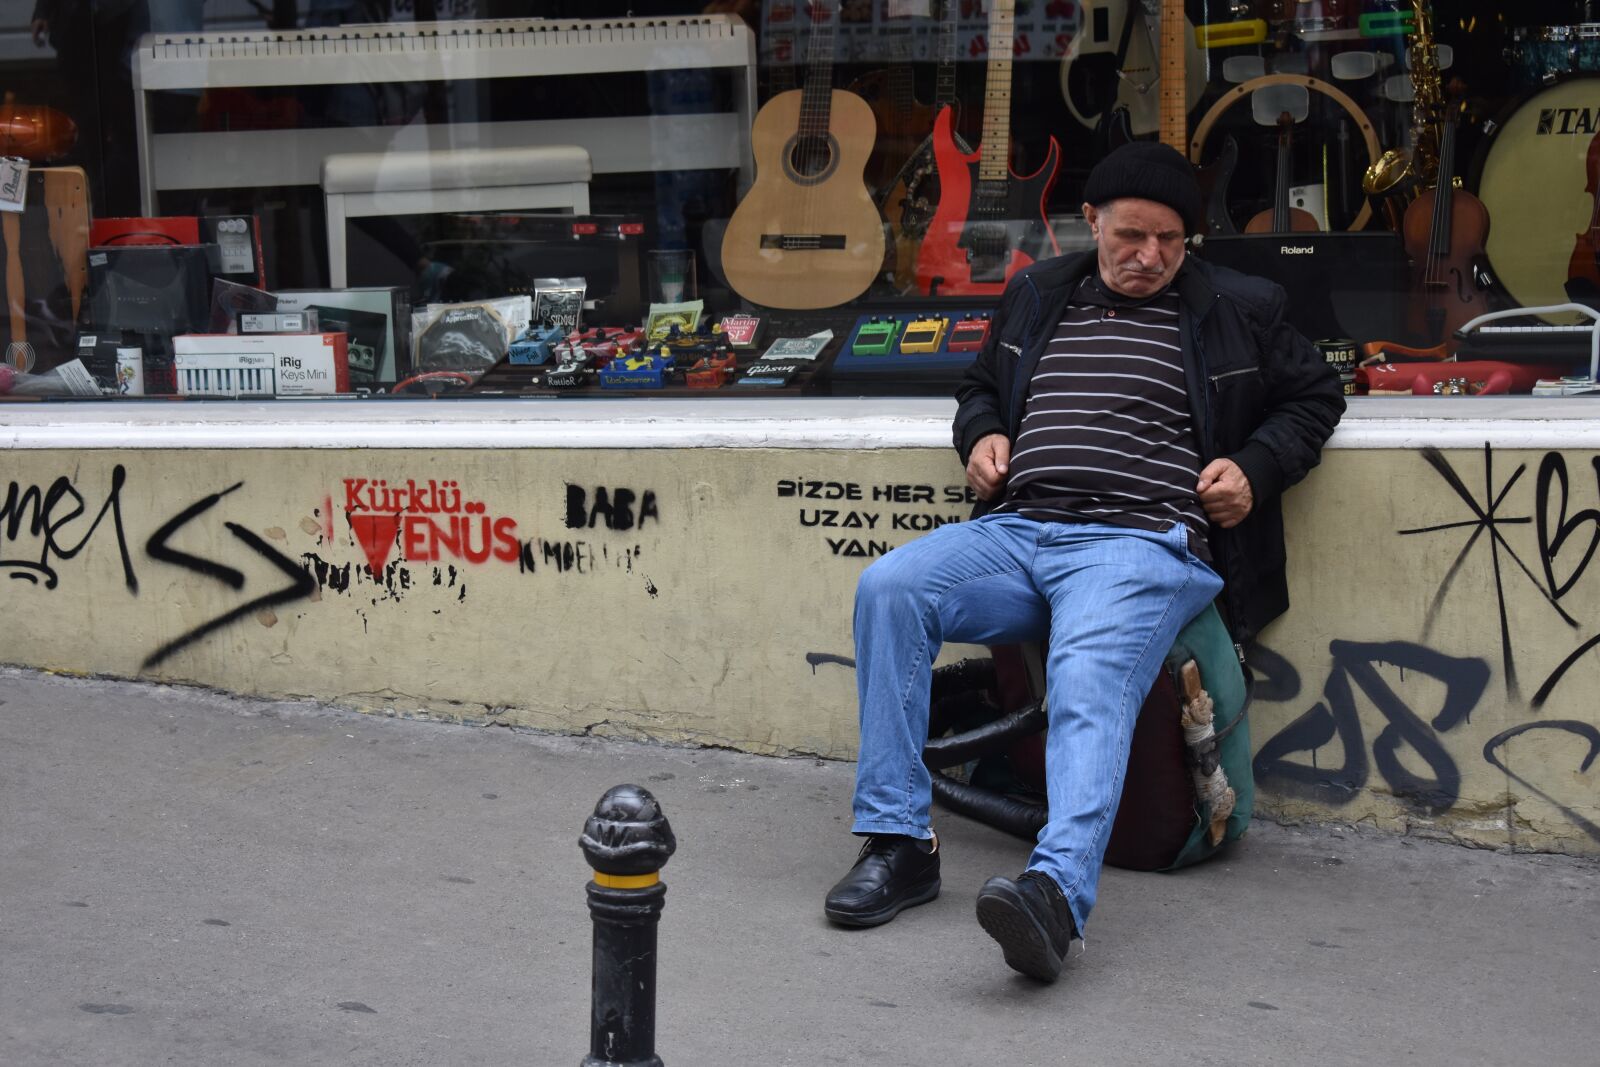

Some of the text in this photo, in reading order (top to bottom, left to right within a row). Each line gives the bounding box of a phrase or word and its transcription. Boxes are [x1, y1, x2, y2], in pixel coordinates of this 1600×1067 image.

[1556, 107, 1600, 134] TA
[1281, 245, 1314, 255] Roland
[724, 319, 757, 327] Martin
[728, 330, 745, 340] SP
[280, 356, 301, 368] iRig
[1325, 350, 1347, 362] BIG
[280, 369, 327, 382] Keys Mini
[747, 365, 796, 376] Gibson
[343, 479, 462, 514] Kürklü
[873, 484, 935, 504] HER
[565, 484, 660, 531] BABA
[800, 509, 880, 530] UZAY
